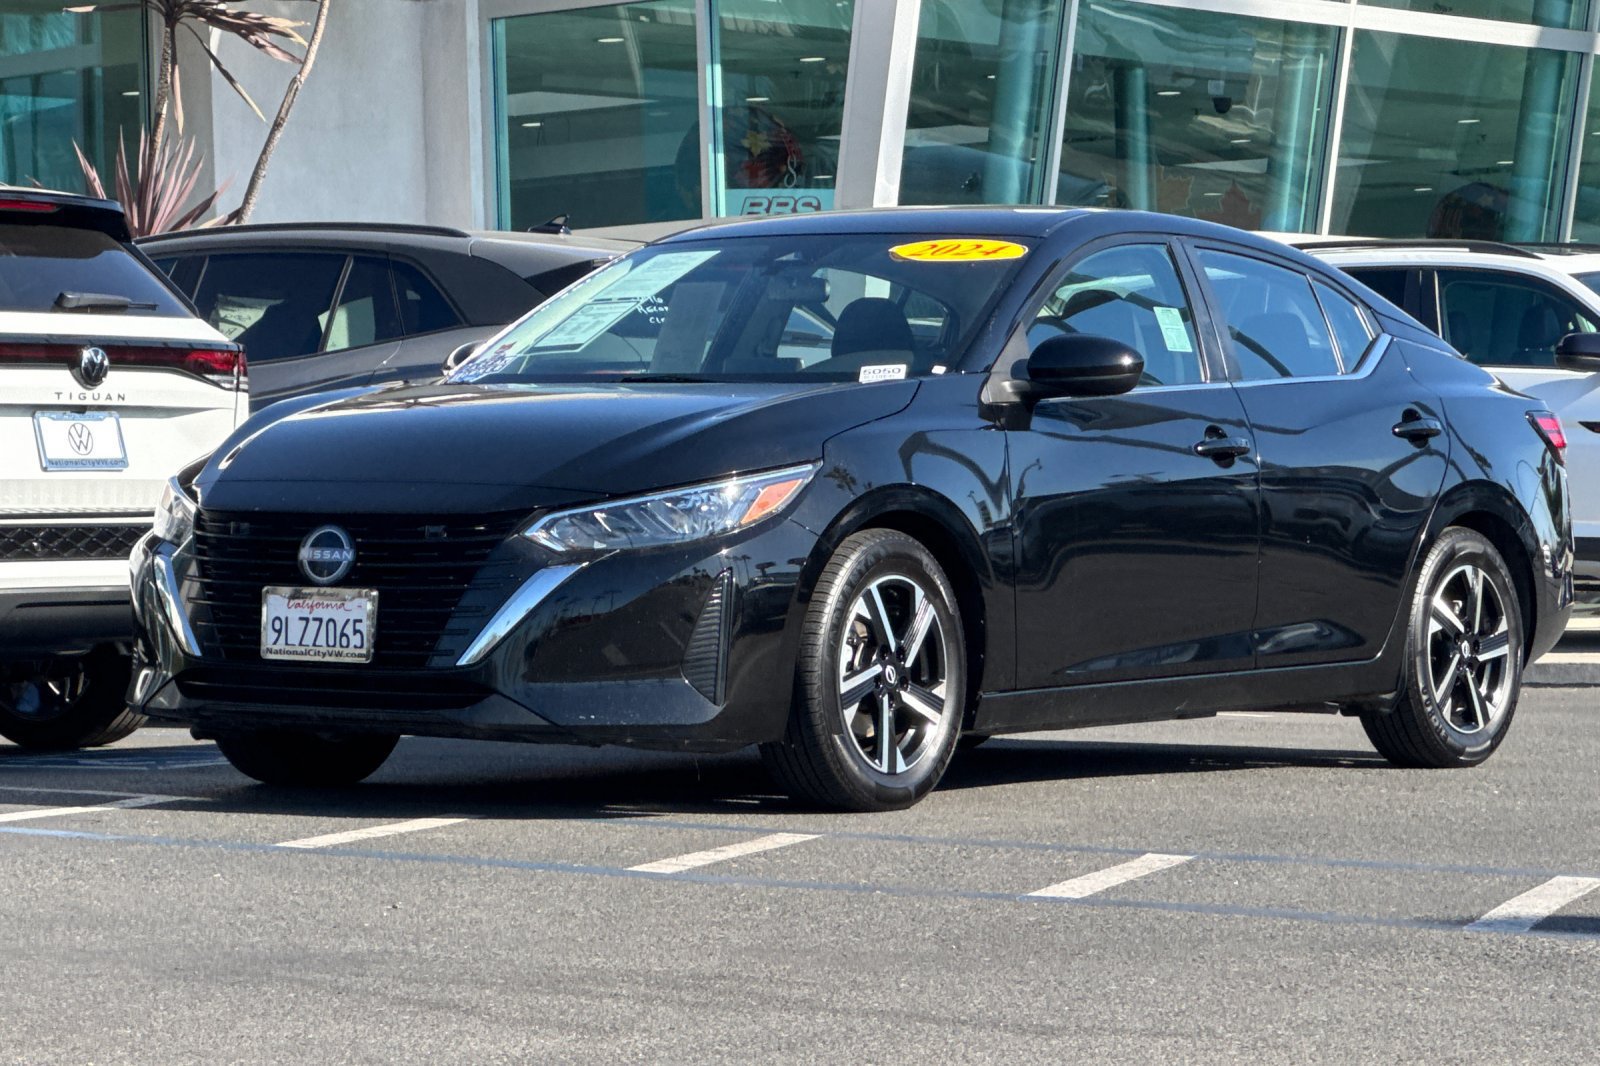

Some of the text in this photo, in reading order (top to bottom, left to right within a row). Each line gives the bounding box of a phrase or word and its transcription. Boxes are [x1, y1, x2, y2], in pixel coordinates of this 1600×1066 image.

[905, 244, 1011, 256] 2024
[55, 391, 126, 402] TIGUAN
[287, 600, 353, 614] California
[271, 616, 365, 649] 9LZZ065
[265, 647, 366, 658] NationalCityVW.com
